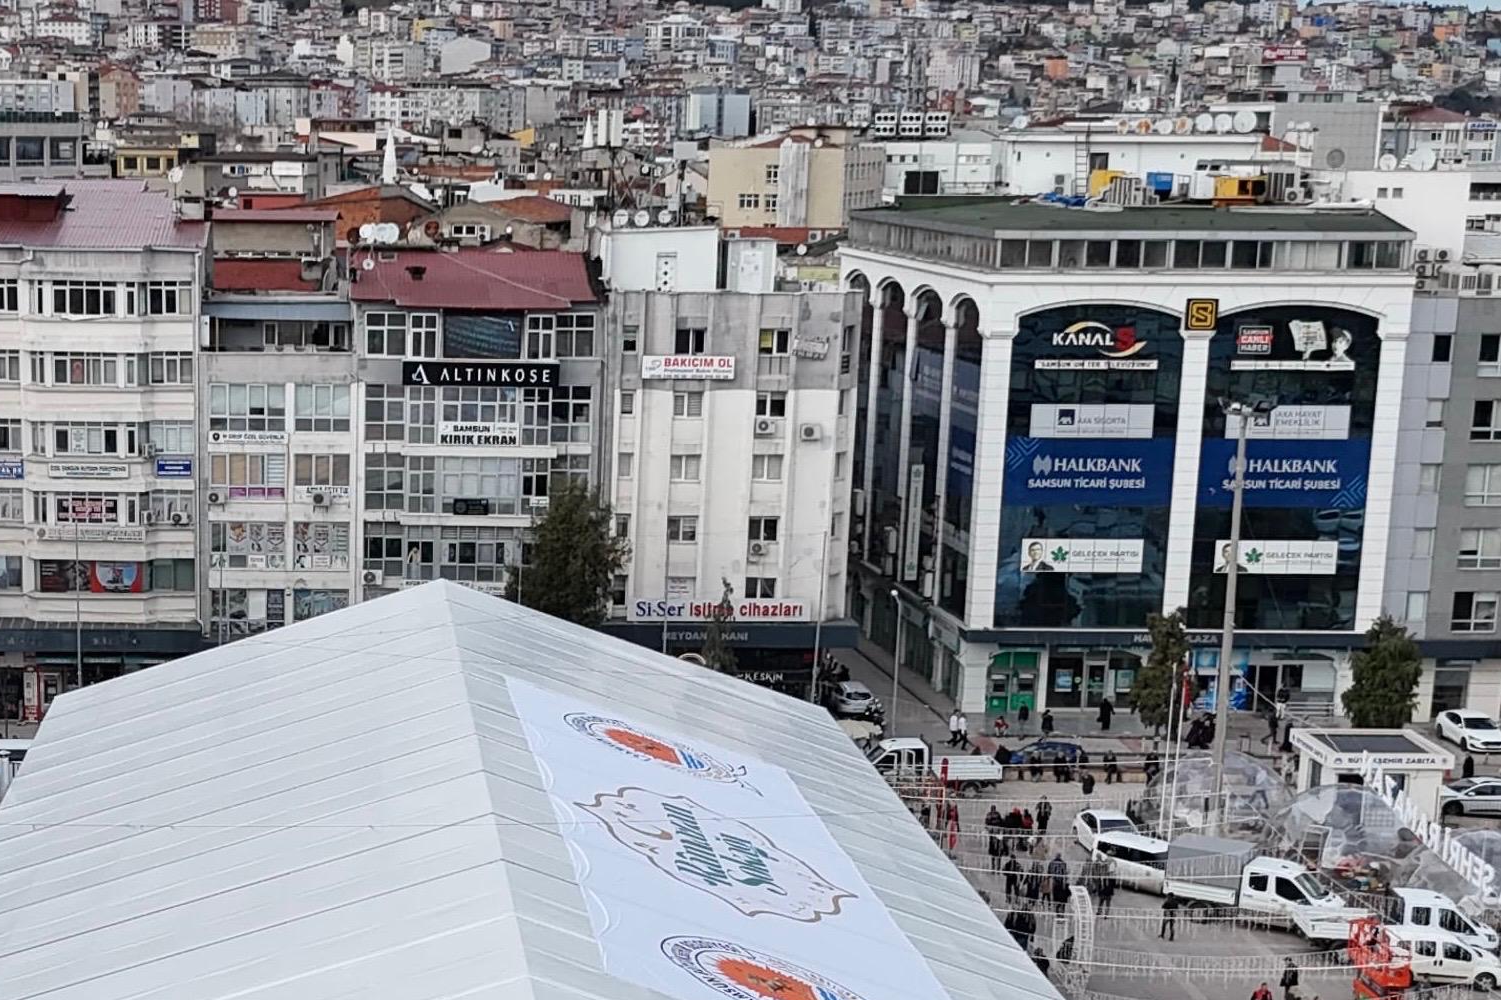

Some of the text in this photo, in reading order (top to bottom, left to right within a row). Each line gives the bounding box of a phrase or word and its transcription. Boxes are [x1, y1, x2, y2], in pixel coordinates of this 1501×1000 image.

[1052, 333, 1115, 346] KANAL
[718, 357, 733, 367] OL
[440, 434, 516, 445] KIRIK EKRAN
[1054, 458, 1142, 473] HALKBANK
[1249, 459, 1338, 473] HALKBANK
[1028, 476, 1146, 490] SAMSUN TİCARİ ŞUBESİ
[1222, 476, 1341, 491] SASUN TİCARİ ŞUBESİ
[739, 602, 803, 617] cihazları
